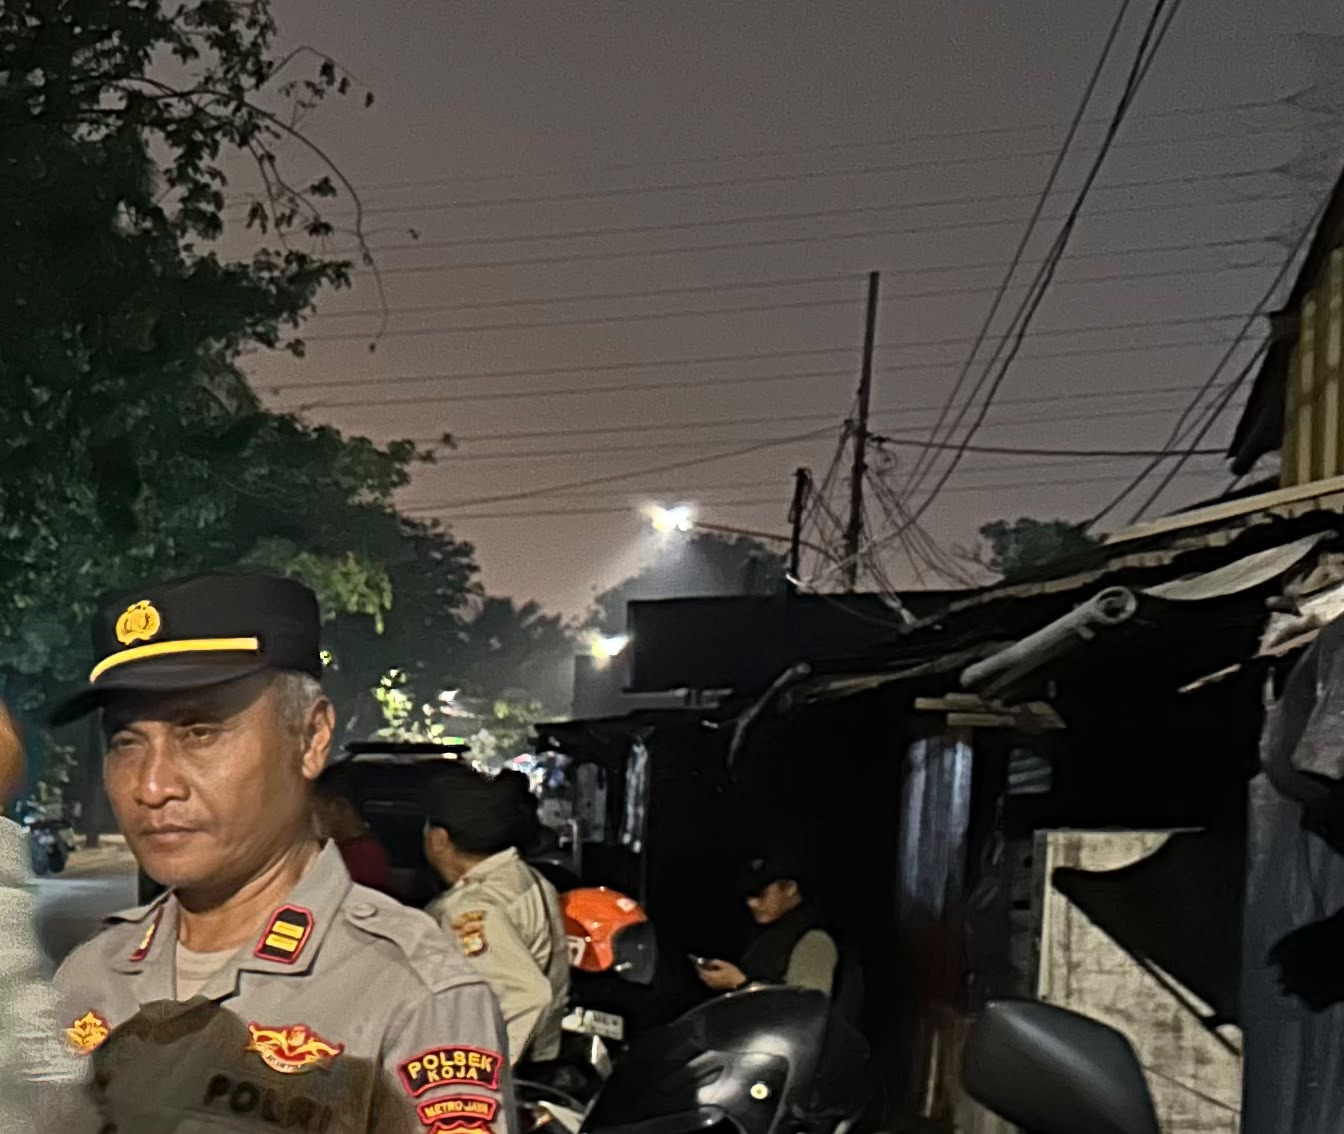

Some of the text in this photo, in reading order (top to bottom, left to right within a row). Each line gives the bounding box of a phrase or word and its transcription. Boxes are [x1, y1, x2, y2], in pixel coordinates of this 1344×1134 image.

[407, 1051, 493, 1079] POLSEK
[427, 1066, 478, 1082] KOJA
[424, 1101, 463, 1118] METRO
